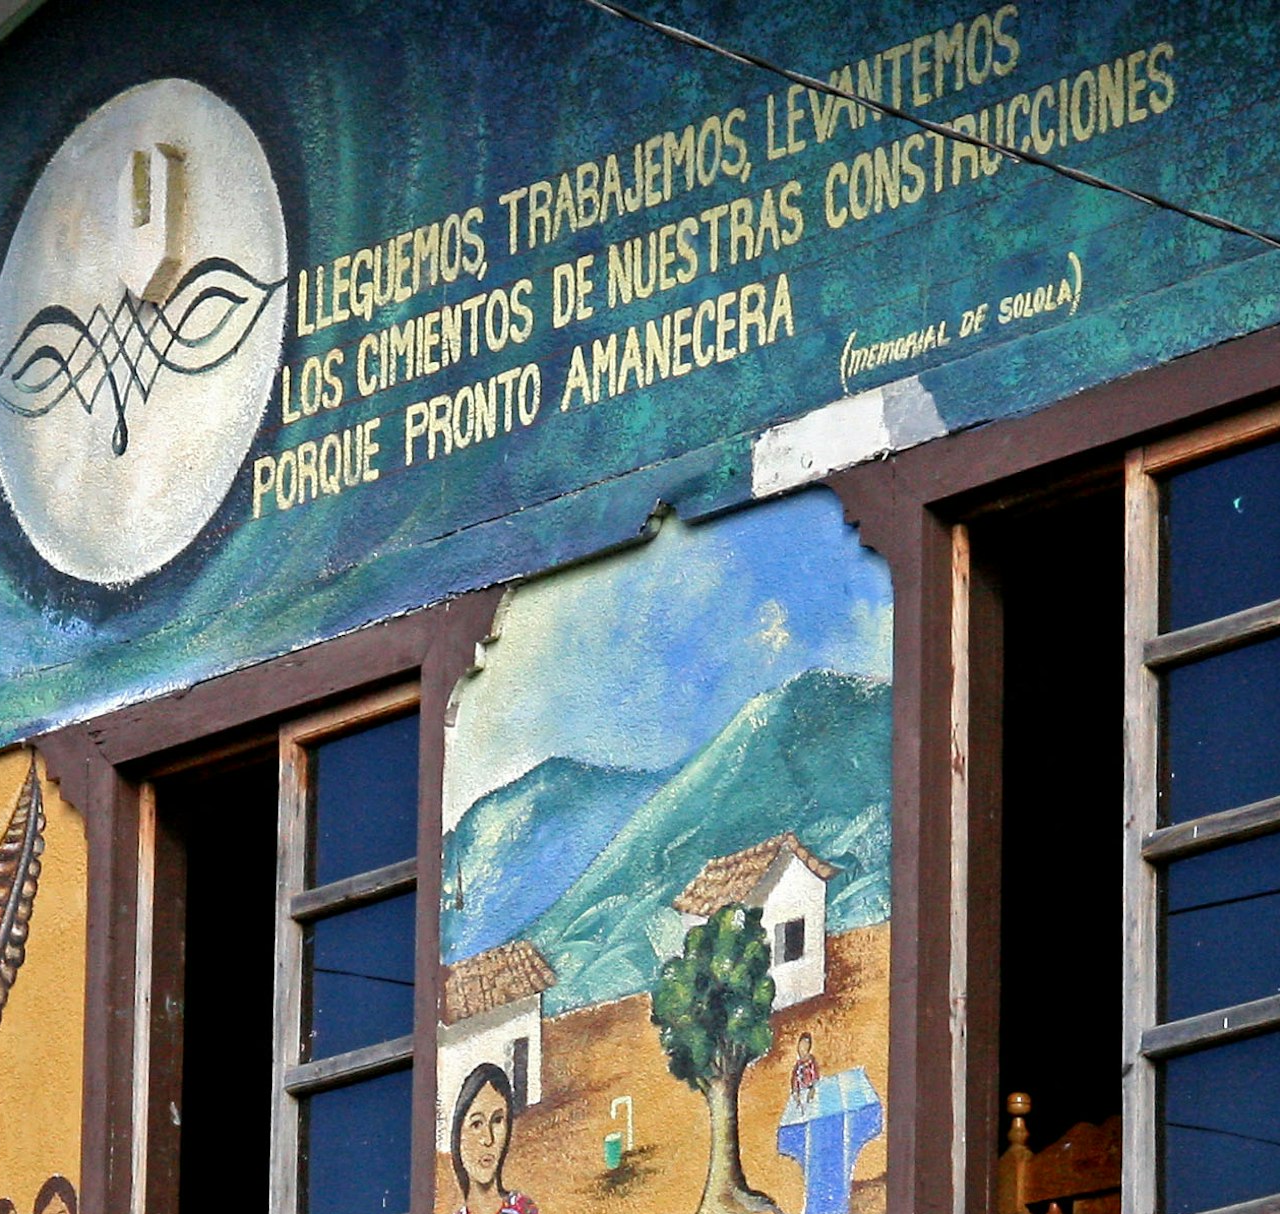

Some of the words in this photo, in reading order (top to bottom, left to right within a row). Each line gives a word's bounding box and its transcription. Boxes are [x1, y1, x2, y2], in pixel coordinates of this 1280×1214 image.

[282, 348, 344, 426] LOS
[356, 279, 534, 397] CIMIENTOS
[552, 254, 594, 329] DE
[607, 182, 804, 309] NUESTRAS
[824, 41, 1175, 229] CONSTRUCCIONES
[298, 206, 488, 338] LLEGUEMOS,
[498, 109, 752, 255] TRABAJEMOS,
[767, 4, 1020, 161] LEVANTEMOS
[252, 417, 380, 519] PORQUE
[404, 362, 542, 466] PRONTO
[560, 272, 795, 412] AMANECERA
[958, 302, 989, 339] DE
